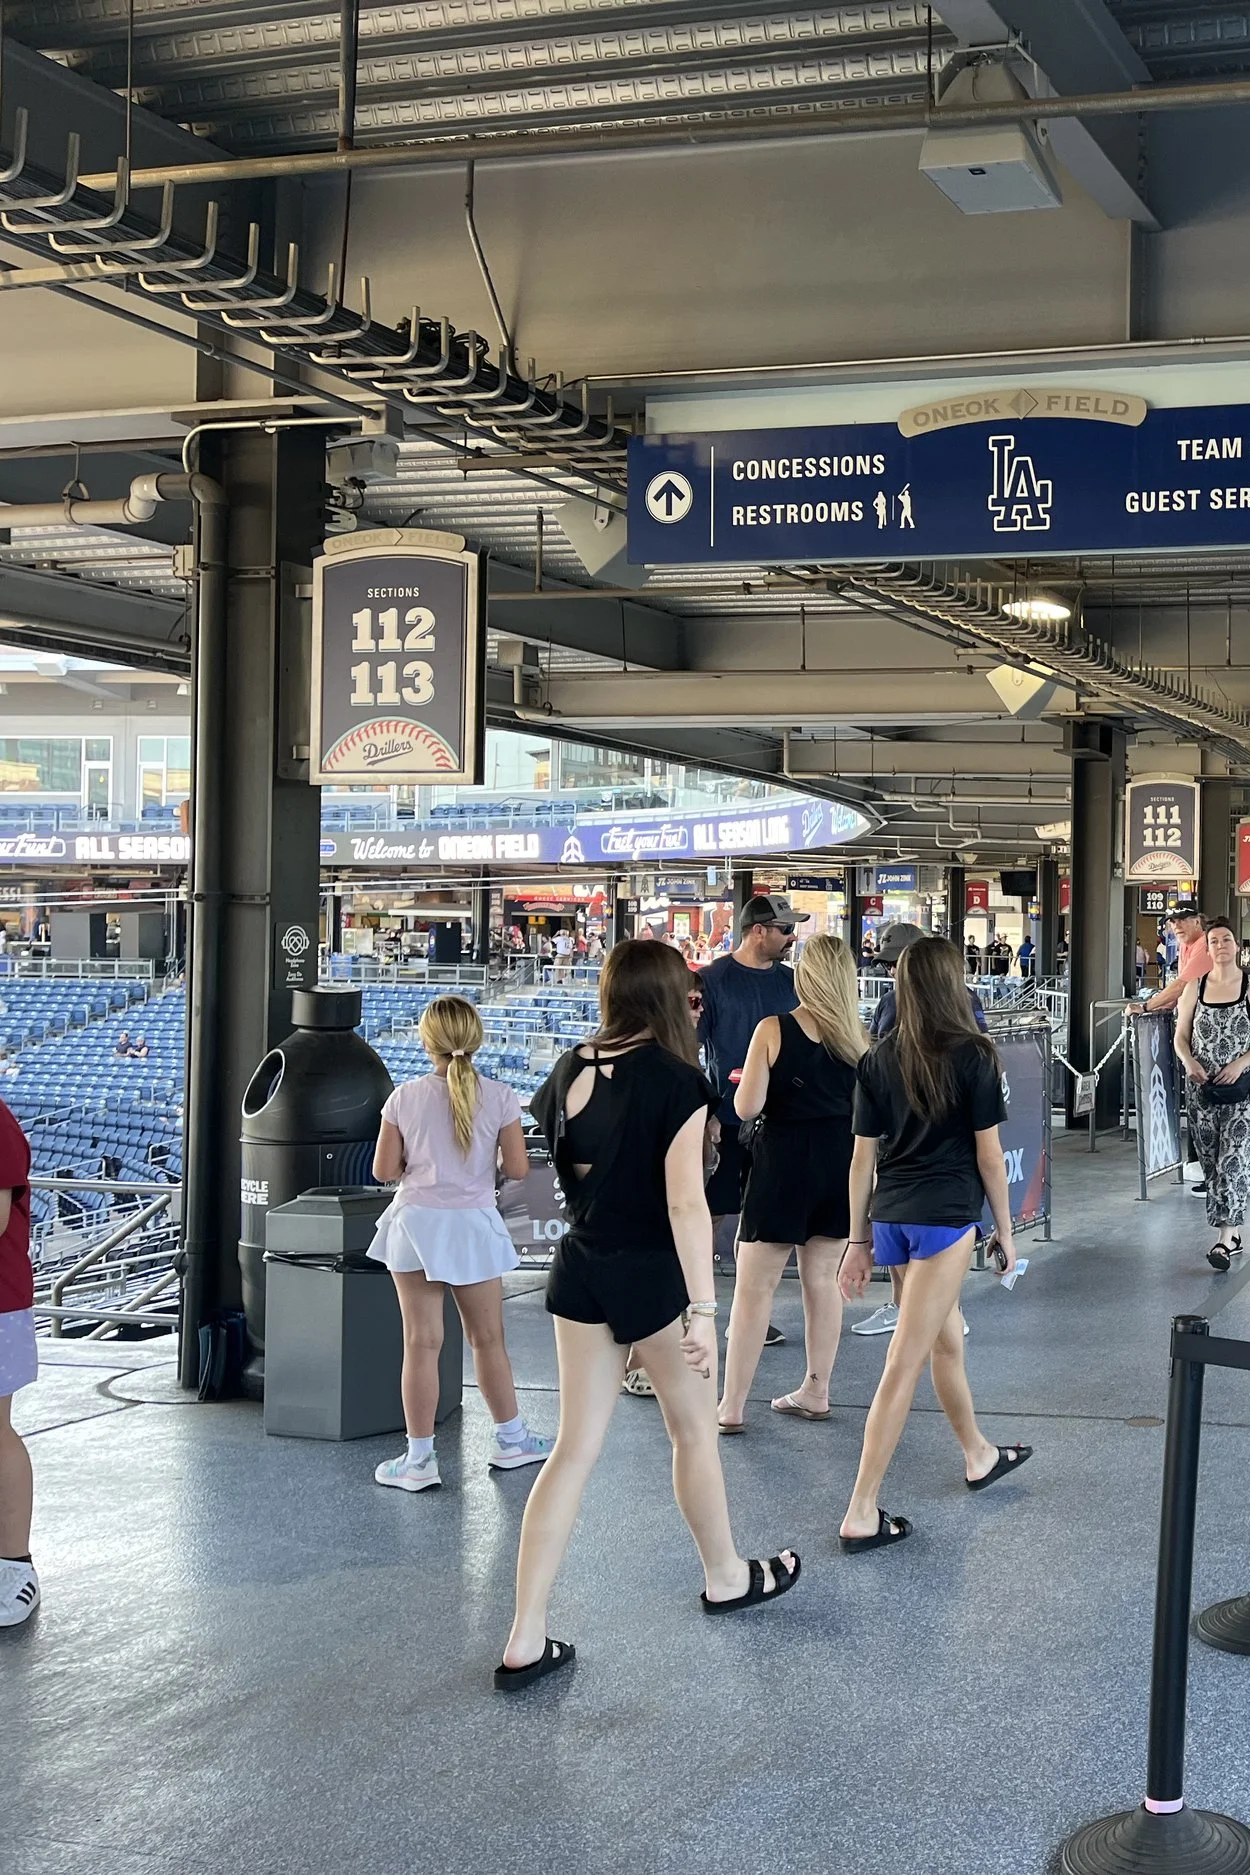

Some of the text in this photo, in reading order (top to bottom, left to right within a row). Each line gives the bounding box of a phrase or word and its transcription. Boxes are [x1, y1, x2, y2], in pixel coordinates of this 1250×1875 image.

[913, 395, 1130, 428] ONEOK FIELD
[1177, 437, 1242, 461] TEAM
[732, 454, 885, 481] CONCESSIONS
[732, 501, 864, 526] RESTROOMS
[1126, 490, 1200, 513] GUEST
[367, 587, 420, 598] SECTIONS
[352, 607, 436, 653] 112
[351, 660, 434, 706] 113
[363, 738, 413, 764] Drillers
[1143, 805, 1182, 825] 111
[495, 834, 539, 859] FIELD
[693, 823, 716, 850] ALL
[718, 819, 761, 849] SEASON
[1143, 827, 1182, 847] 112
[75, 836, 115, 859] ALL
[351, 836, 417, 860] Welcome
[418, 837, 434, 859] to
[973, 896, 980, 904] D
[1146, 892, 1164, 900] 109
[1146, 901, 1164, 909] 110
